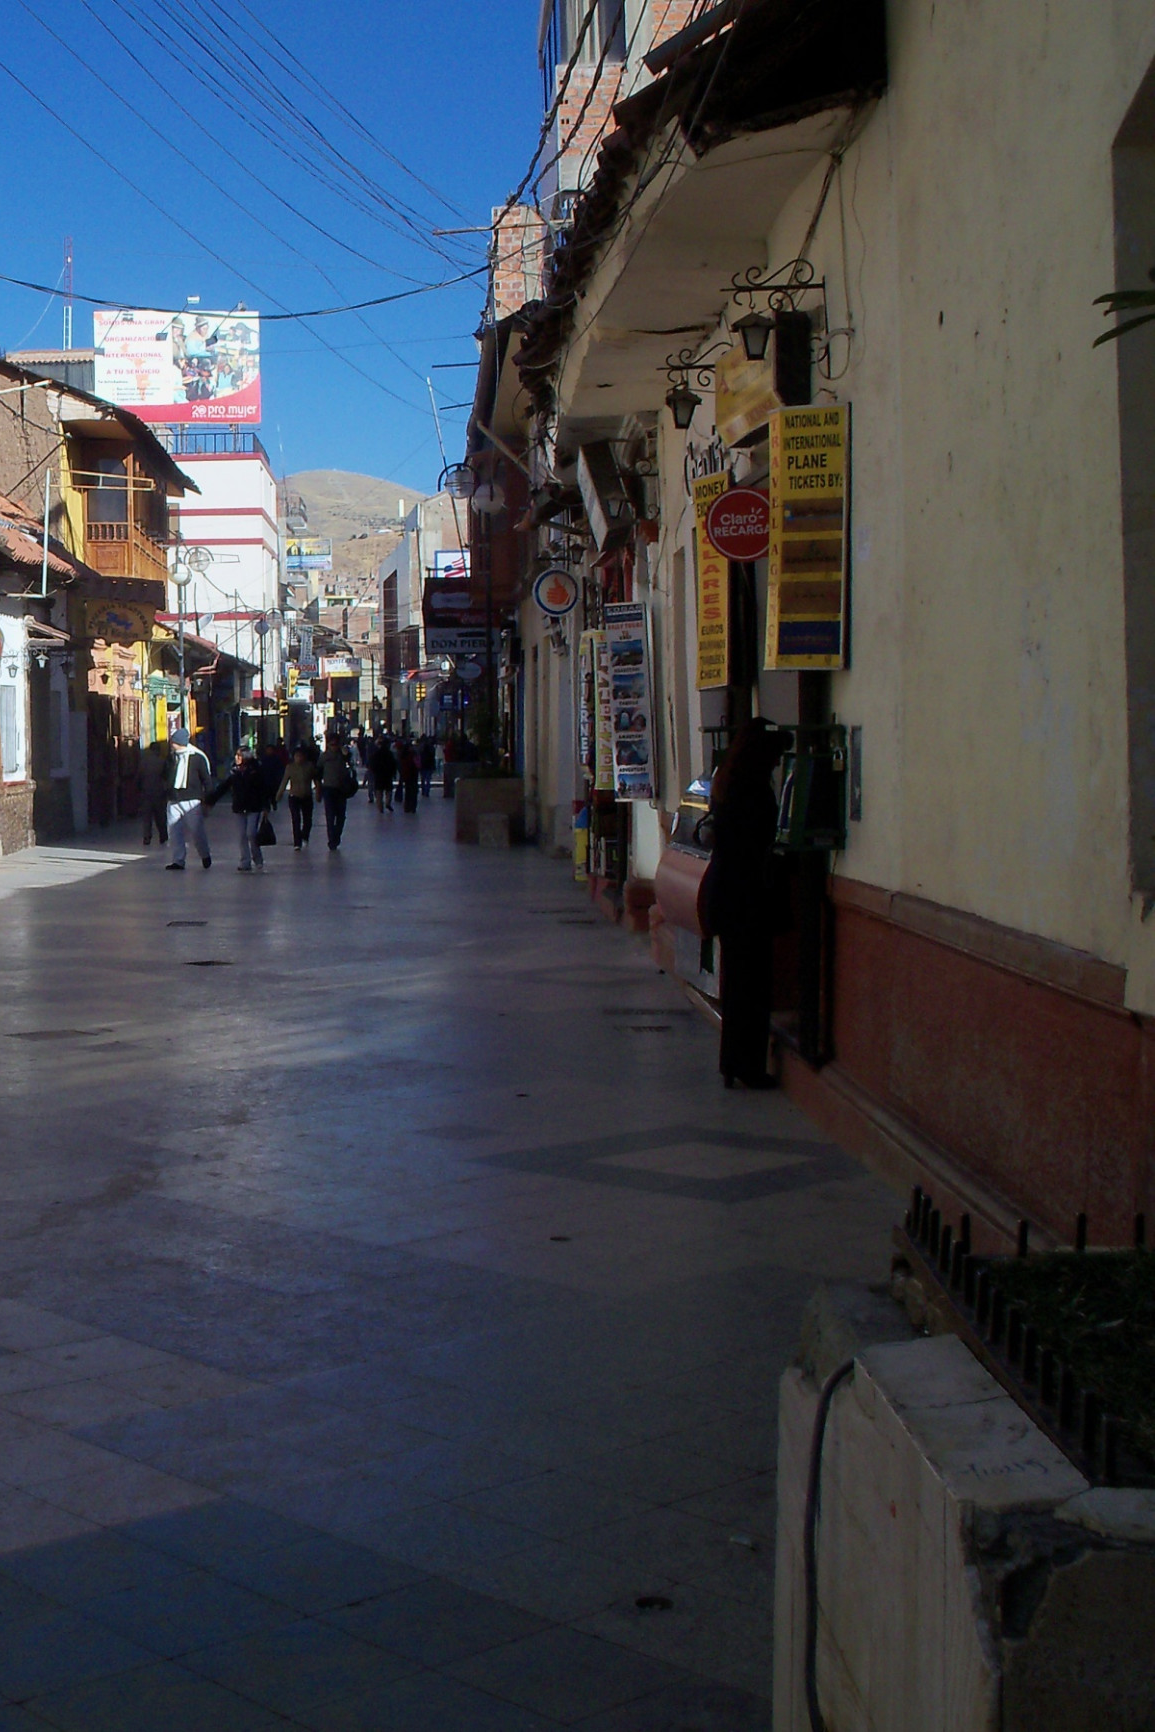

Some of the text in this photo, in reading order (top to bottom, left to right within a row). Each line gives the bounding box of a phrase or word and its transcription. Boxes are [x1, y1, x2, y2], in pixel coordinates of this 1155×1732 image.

[207, 404, 226, 418] pro
[228, 404, 257, 418] mujer
[784, 413, 821, 429] NATIONAL
[823, 411, 839, 426] AND
[783, 433, 841, 450] INTERNATIONAL
[787, 453, 828, 470] PLANE
[770, 419, 780, 530] TRAVEL
[789, 472, 843, 490] TICKETS BY:
[695, 480, 725, 500] MONEY
[720, 511, 758, 526] Claro
[431, 640, 456, 649] DON
